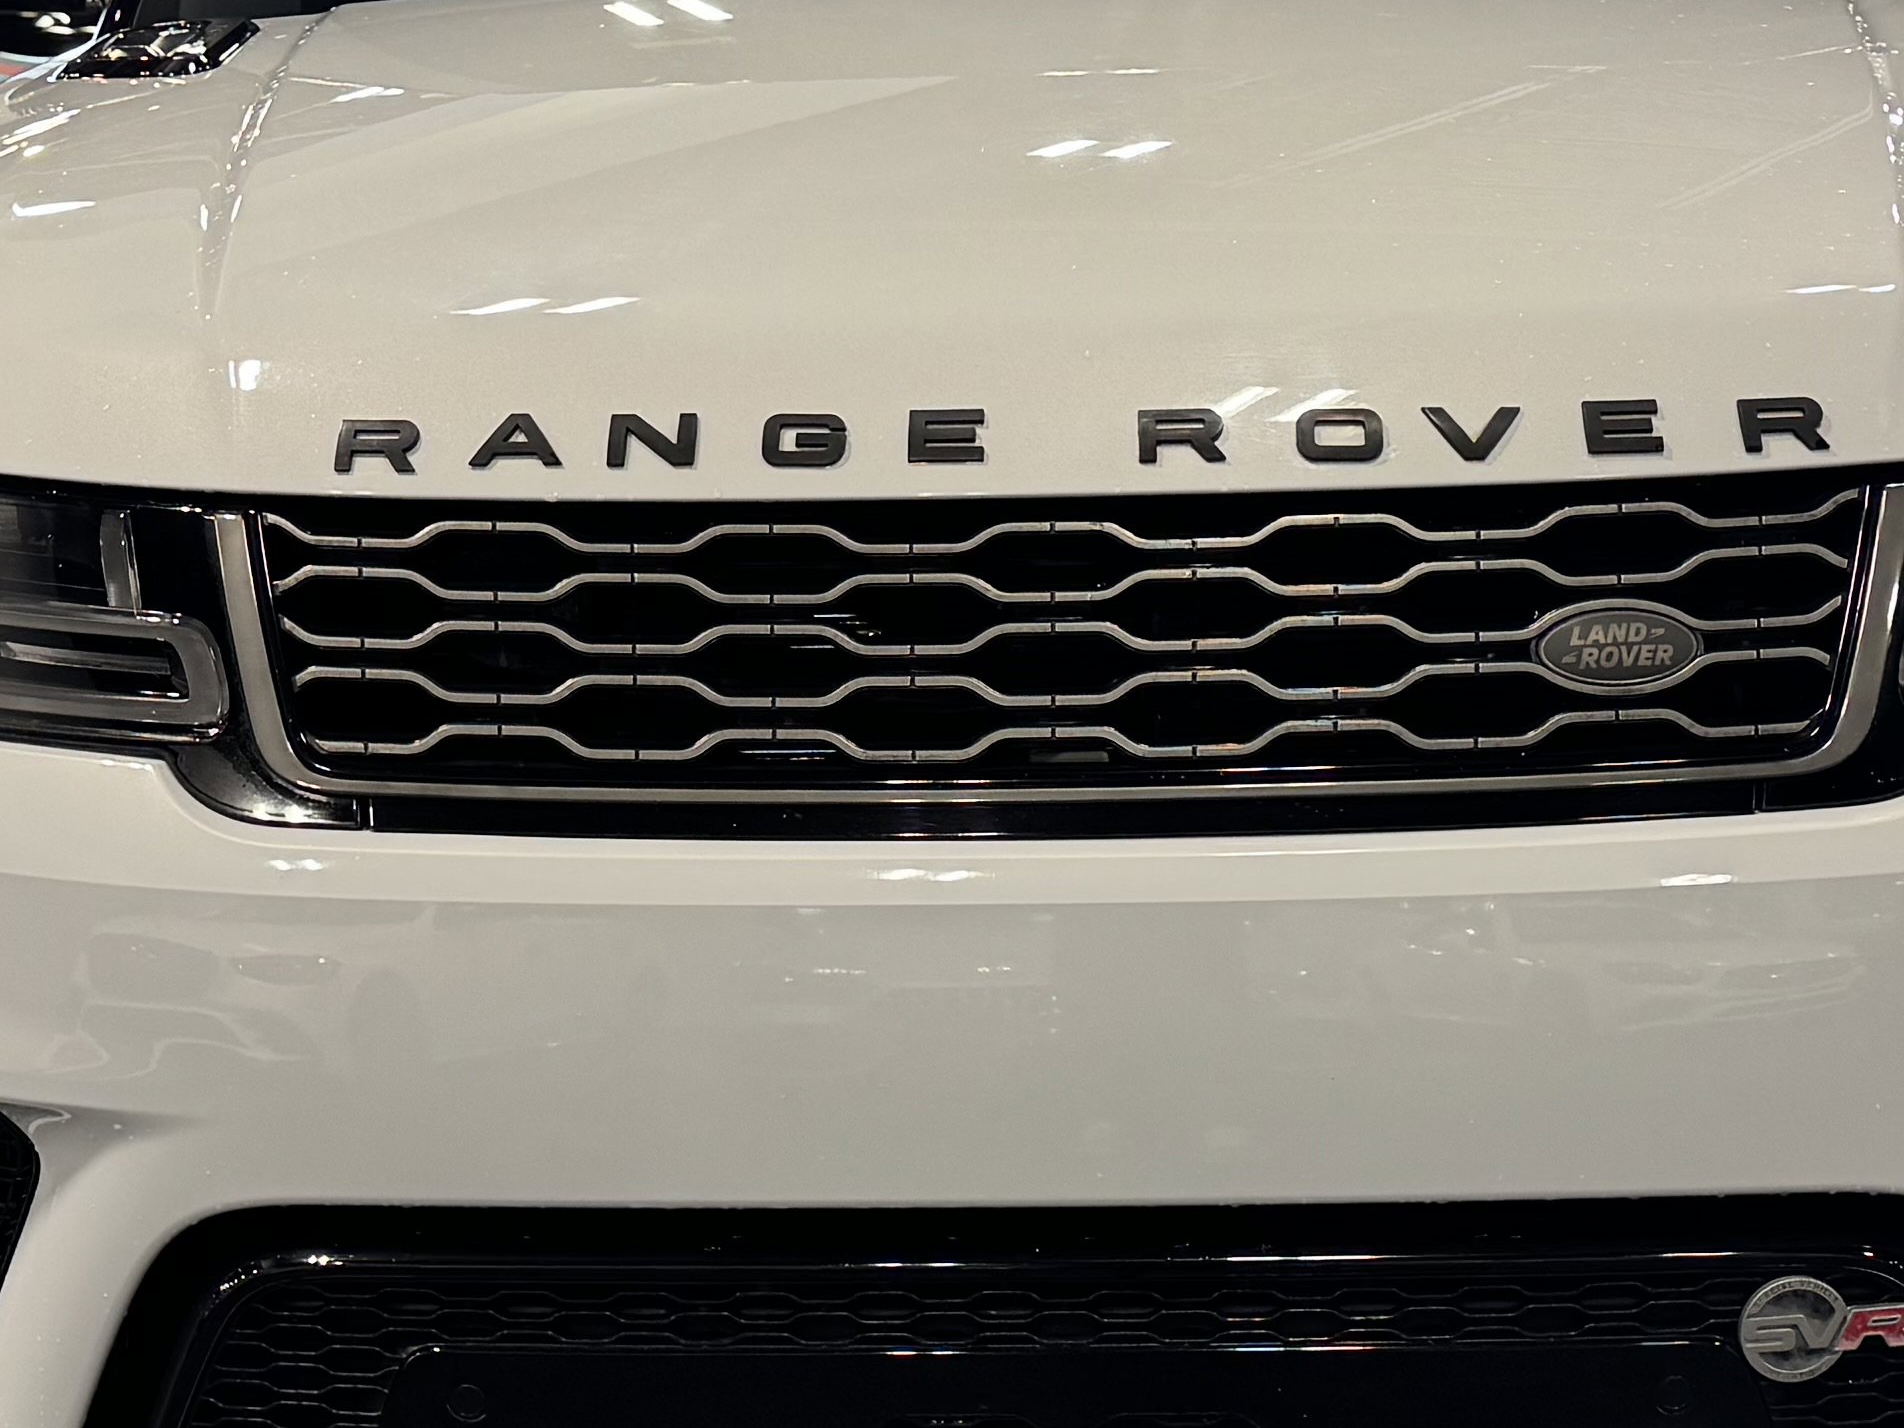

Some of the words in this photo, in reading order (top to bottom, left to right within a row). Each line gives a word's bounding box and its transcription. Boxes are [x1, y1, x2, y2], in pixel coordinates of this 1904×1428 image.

[333, 407, 986, 475] RANGE
[1137, 396, 1832, 465] ROVER
[1569, 622, 1648, 647] LAND
[1578, 644, 1675, 670] ROVER
